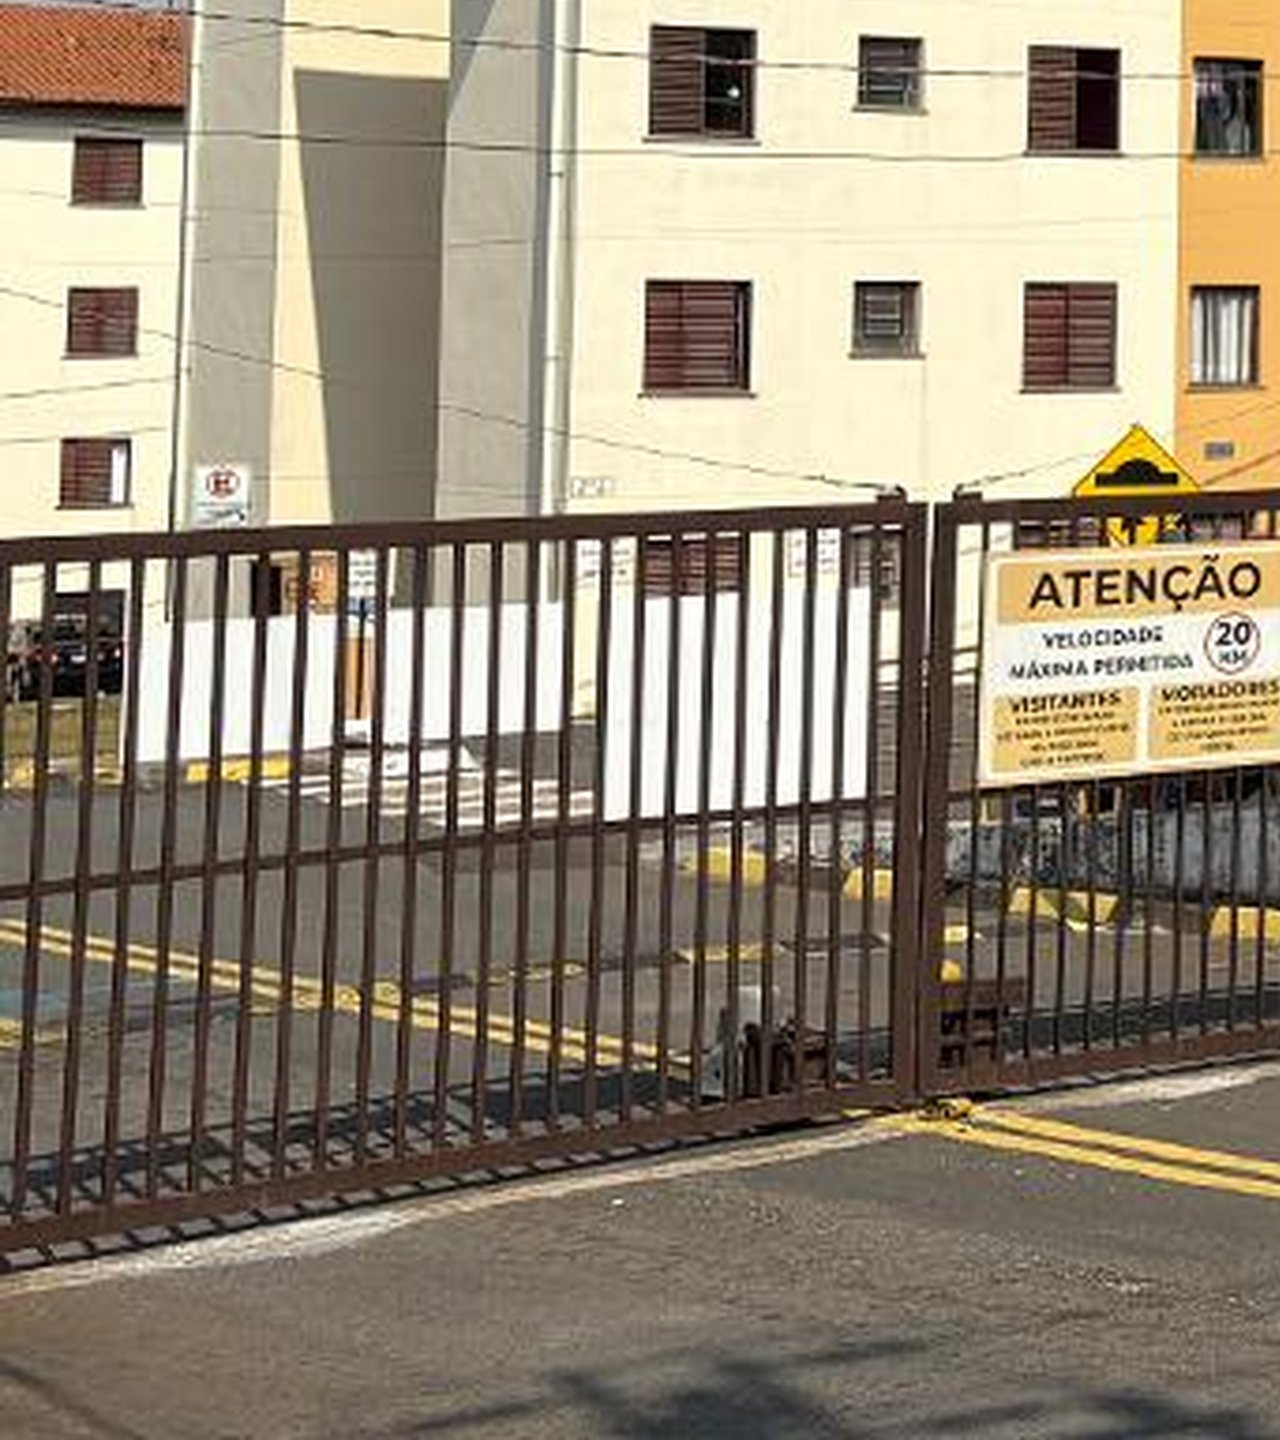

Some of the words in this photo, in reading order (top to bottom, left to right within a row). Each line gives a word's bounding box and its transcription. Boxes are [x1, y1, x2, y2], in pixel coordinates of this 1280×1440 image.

[1029, 554, 1262, 612] ATENÇÃO
[1042, 626, 1163, 650] VELOCIDADE
[1214, 621, 1251, 647] 20
[1008, 656, 1088, 681] MÁXIMA
[1094, 653, 1194, 676] PERMITIDA
[1009, 689, 1122, 714] VISITANTES
[1161, 678, 1280, 703] MORADORES
